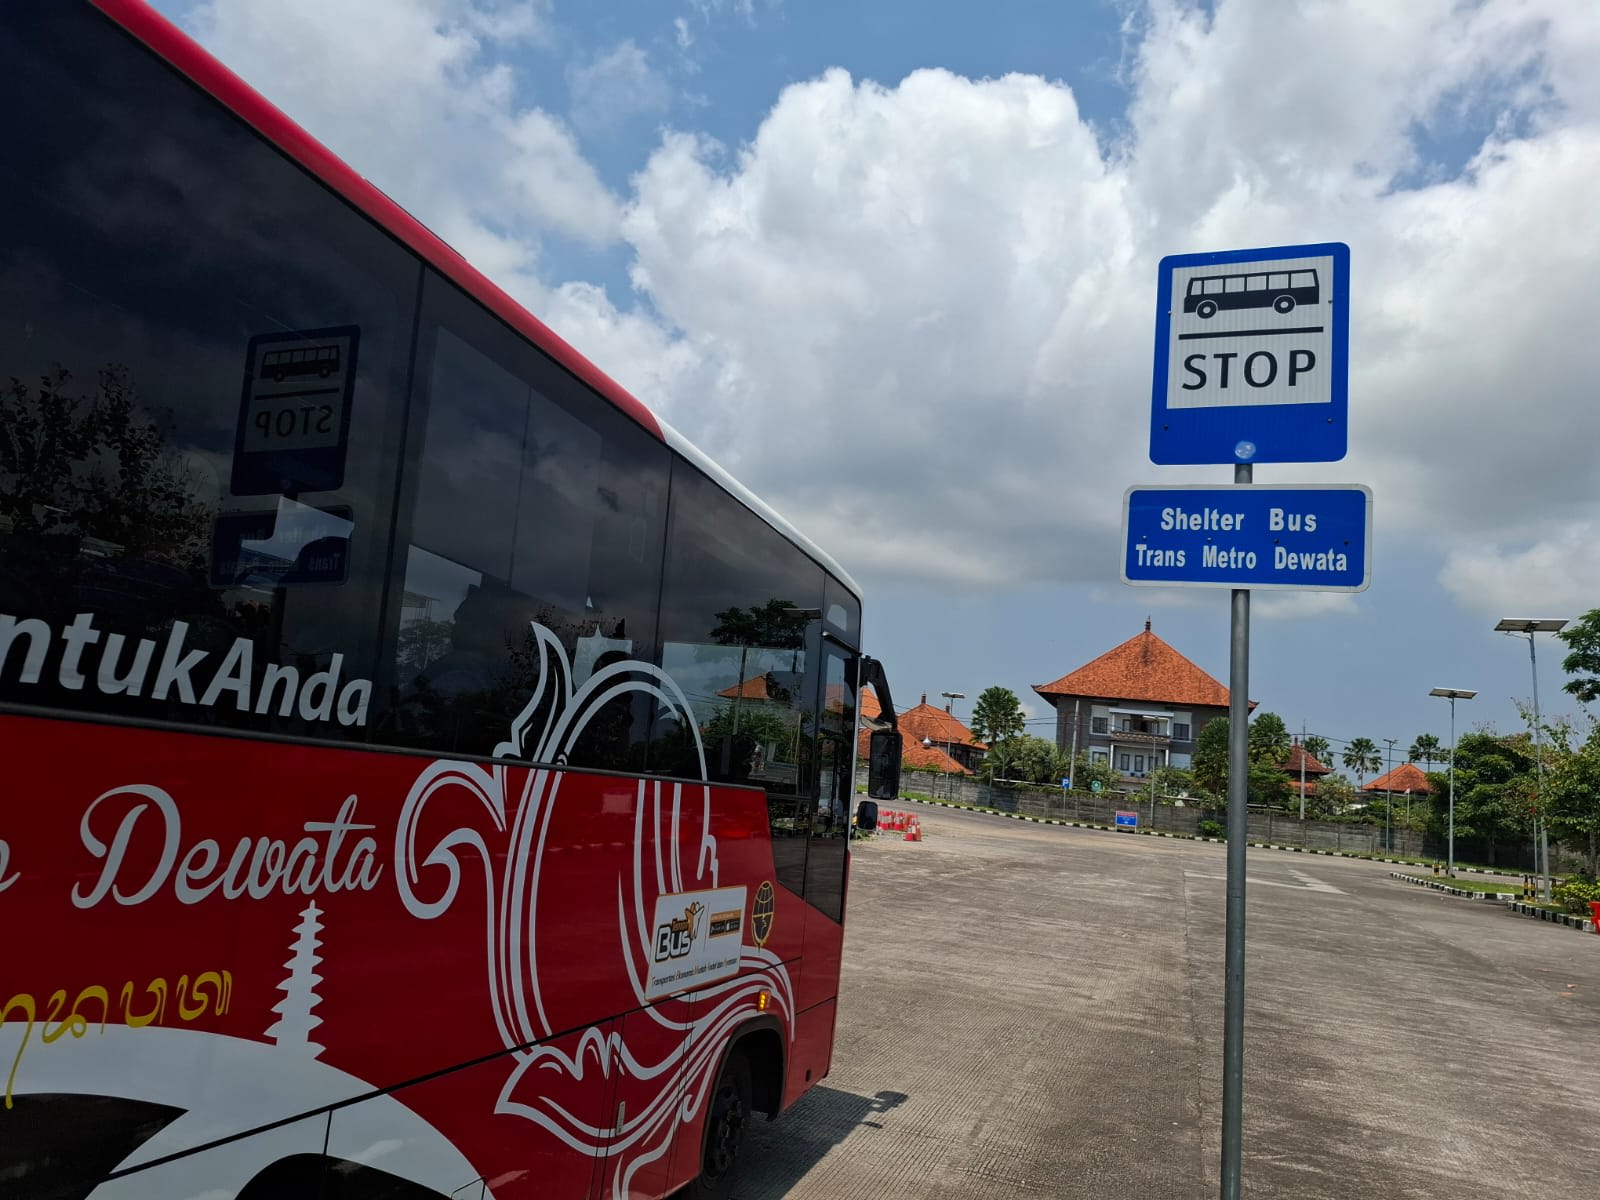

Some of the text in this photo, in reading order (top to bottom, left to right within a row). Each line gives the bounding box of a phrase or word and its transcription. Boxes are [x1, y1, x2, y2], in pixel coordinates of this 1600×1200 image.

[1182, 349, 1316, 391] STOP
[1161, 507, 1317, 532] Shelter Bus
[1135, 544, 1347, 571] Trans Metro Dewata
[71, 784, 384, 910] Dewata
